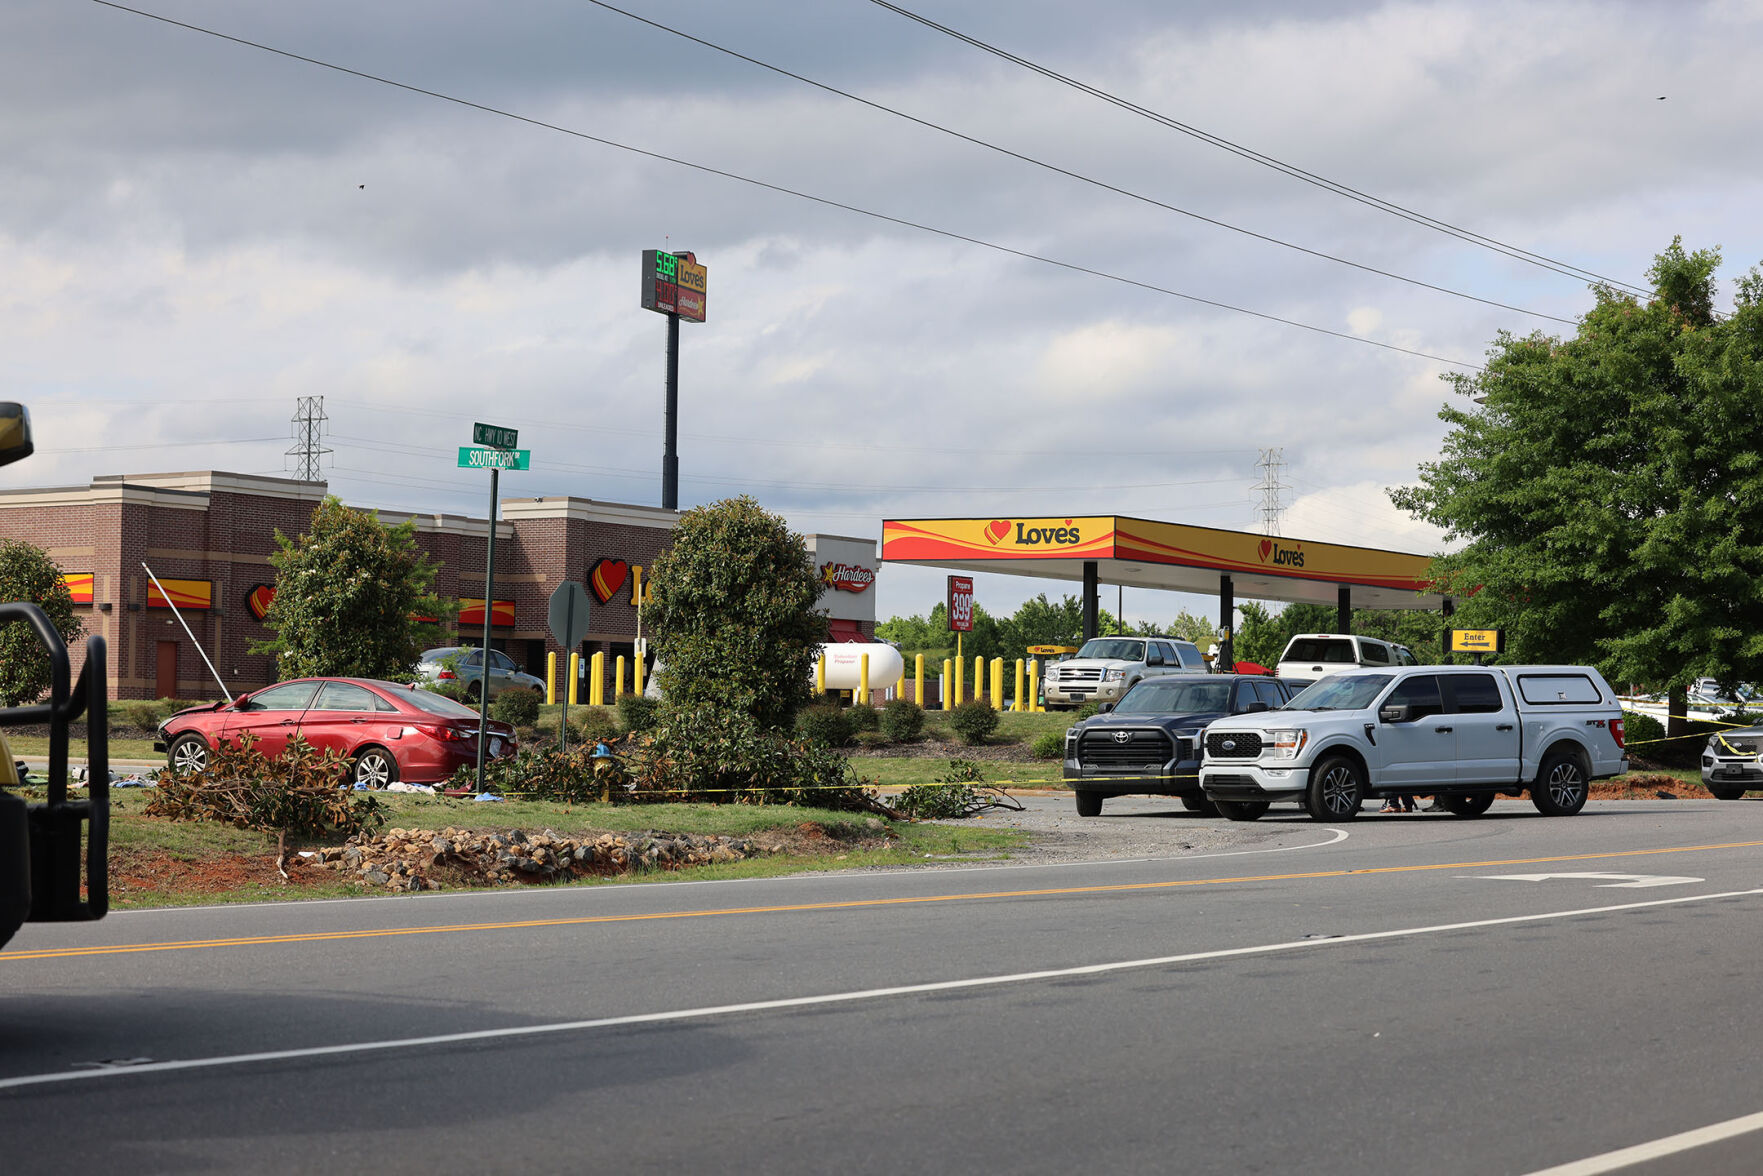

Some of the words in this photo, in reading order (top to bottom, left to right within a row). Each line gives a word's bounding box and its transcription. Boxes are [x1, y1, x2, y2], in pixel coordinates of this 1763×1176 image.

[485, 428, 497, 443] HWY
[504, 431, 516, 446] WEST
[468, 450, 514, 467] SOUTHFORK
[955, 581, 971, 590] Propane
[1464, 633, 1486, 641] Enter
